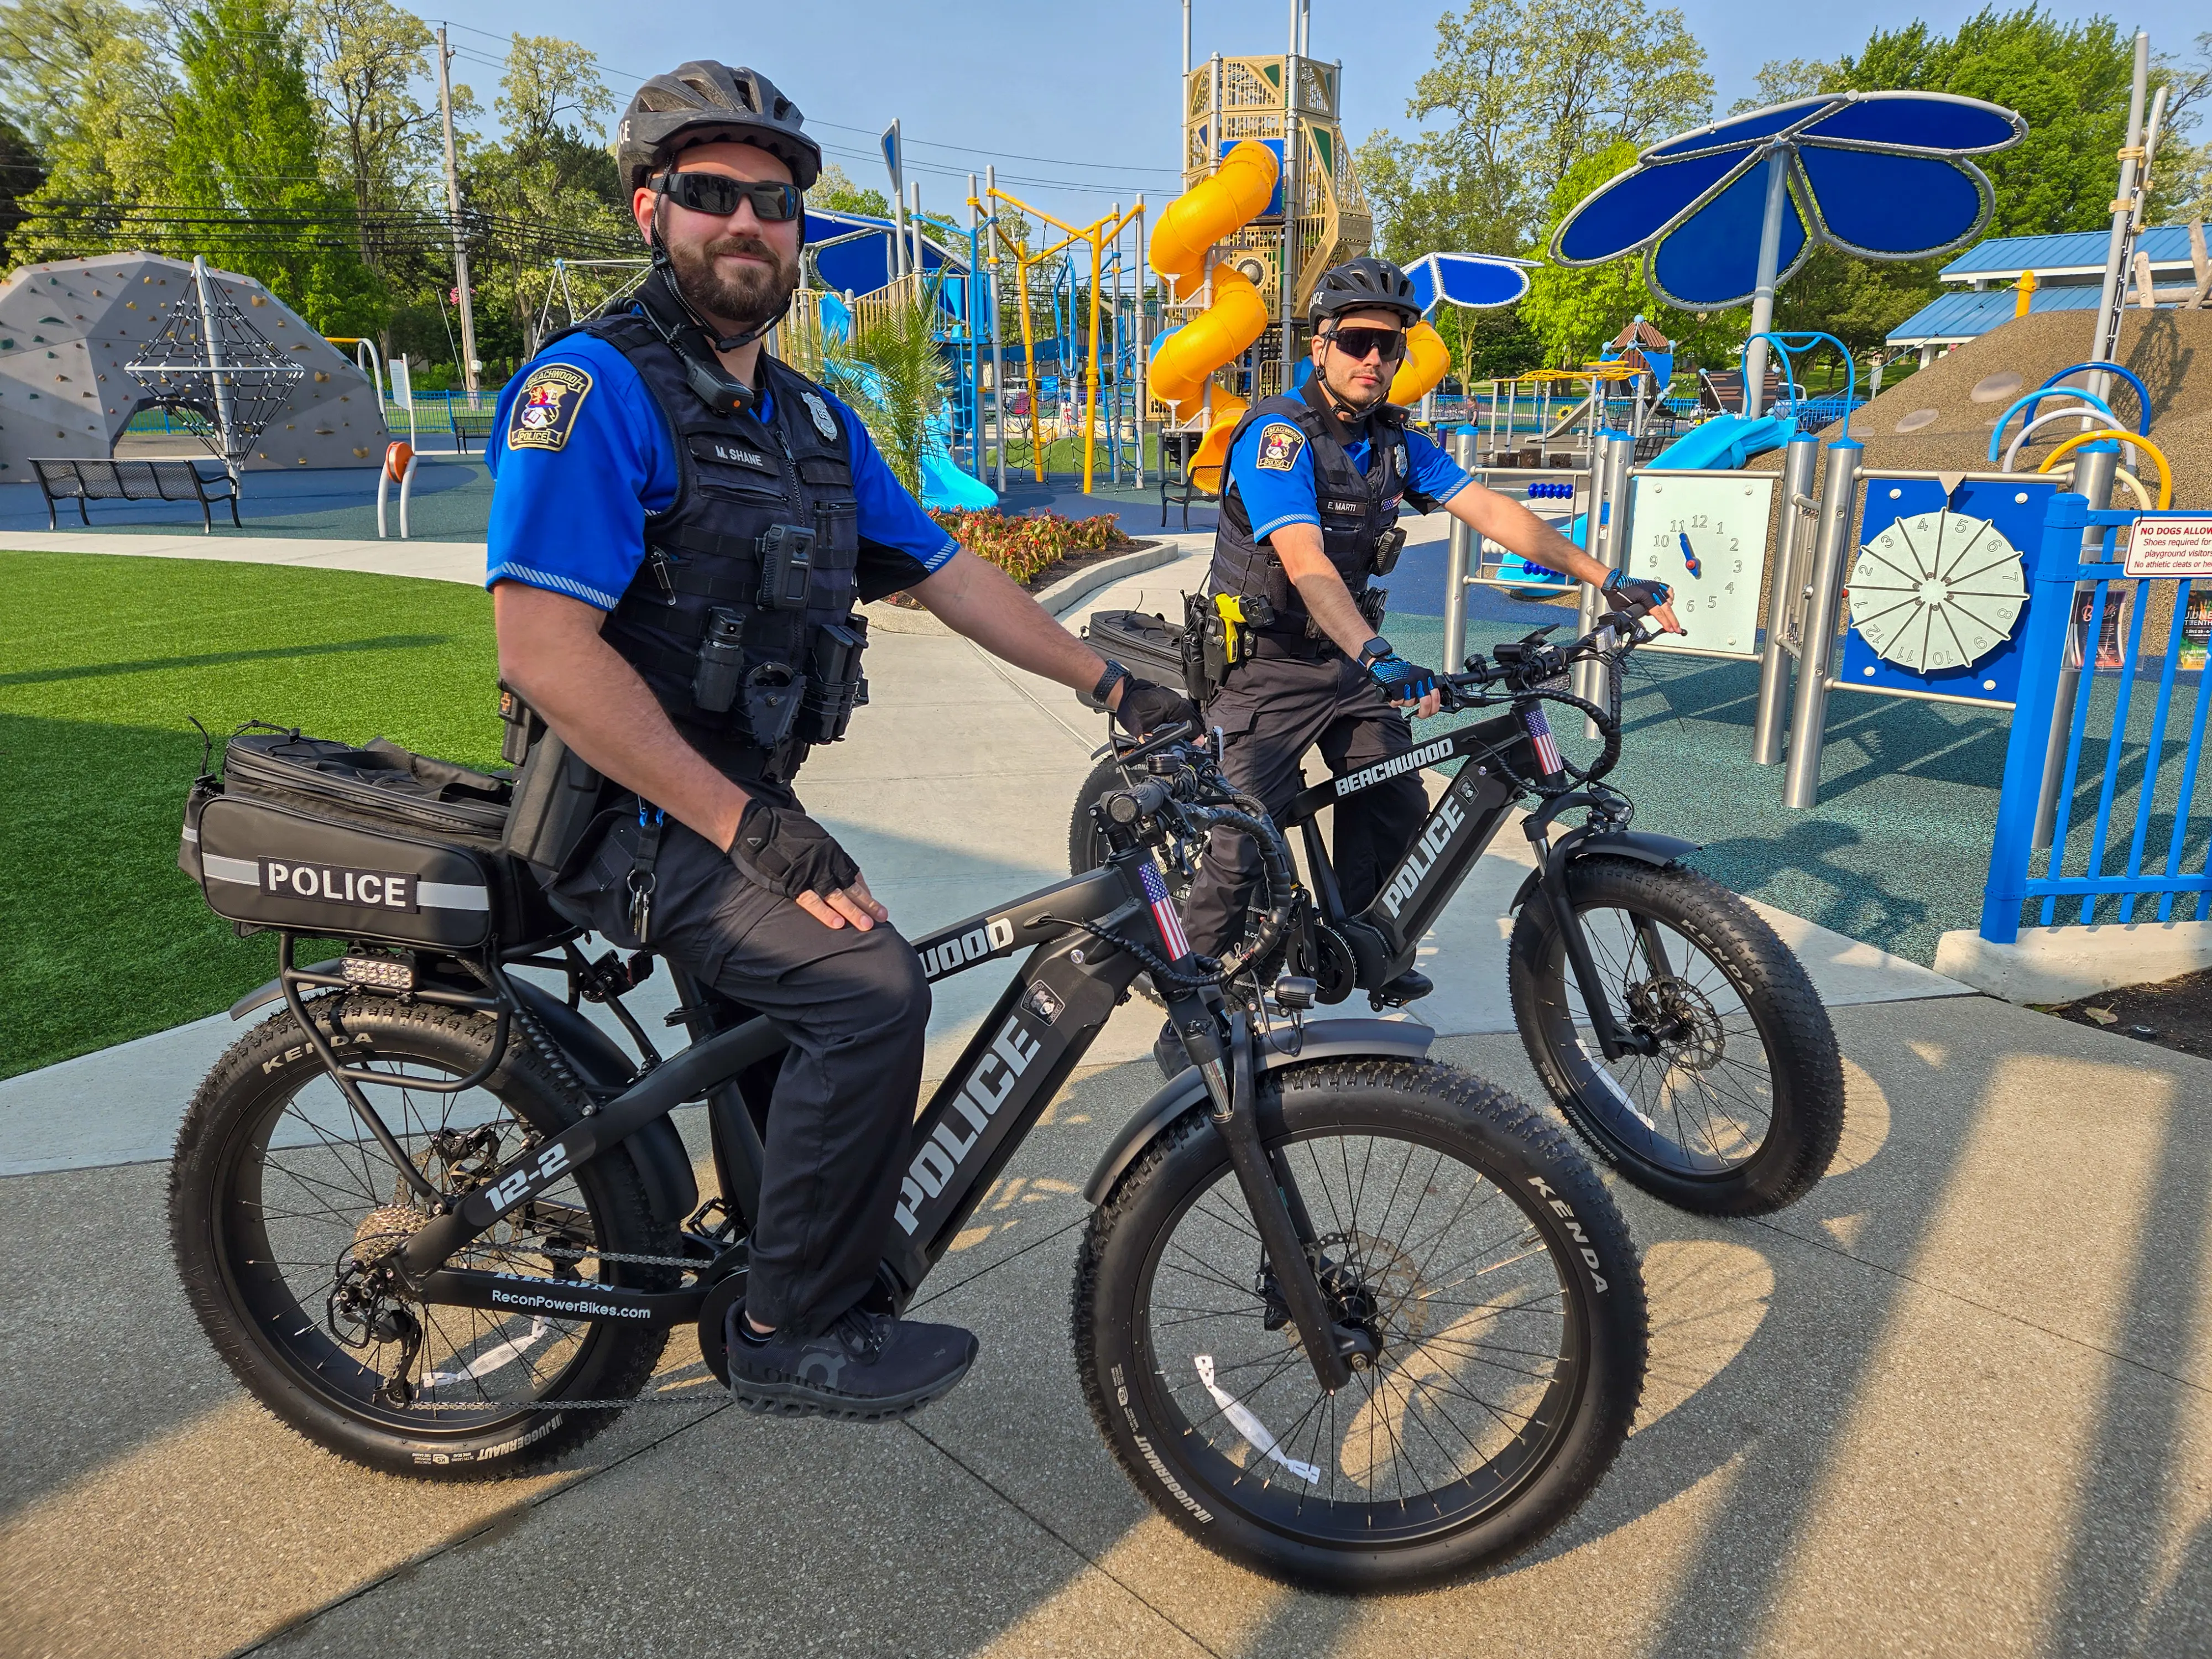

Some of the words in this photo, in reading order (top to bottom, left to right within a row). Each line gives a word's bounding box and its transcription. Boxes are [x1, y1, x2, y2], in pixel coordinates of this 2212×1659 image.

[519, 432, 547, 441] POLICE
[715, 445, 728, 460] M.
[729, 448, 763, 466] SHANE
[1335, 502, 1357, 512] MARTI
[1670, 520, 1684, 533] 11
[1691, 515, 1708, 528] 12
[1717, 521, 1724, 534] 1
[1917, 518, 1928, 531] 4
[1954, 519, 1969, 534] 5
[1653, 534, 1670, 547] 10
[1729, 538, 1739, 551] 2
[1880, 535, 1895, 549] 3
[1986, 539, 2002, 552] 6
[2168, 538, 2200, 547] required
[2201, 538, 2212, 546] for
[2145, 549, 2187, 559] playground
[1650, 555, 1658, 568] 9
[1733, 560, 1743, 573] 3
[1858, 565, 1873, 577] 2
[2002, 571, 2019, 582] 7
[1725, 581, 1735, 594] 4
[1686, 599, 1695, 613] 6
[1707, 595, 1717, 609] 5
[1997, 608, 2013, 620] 8
[1865, 624, 1885, 644] 12
[1973, 636, 1988, 650] 9
[1897, 646, 1914, 663] 11
[1933, 650, 1954, 666] 10
[1335, 738, 1454, 797] BEACHWOOD
[1382, 795, 1465, 919] POLICE
[268, 863, 406, 907] POLICE
[1681, 919, 1754, 995] KENDA
[894, 1015, 1041, 1237] POLICE
[1564, 1105, 1613, 1157] JUGGERNAUT
[485, 1142, 571, 1212] 12-2
[1527, 1176, 1609, 1293] KENDA
[492, 1290, 651, 1319] ReconPowerBikes.com
[1119, 1391, 1126, 1401] KS
[477, 1419, 555, 1462] JUGGERNAUT
[1133, 1435, 1206, 1519] JUGGERNAUT
